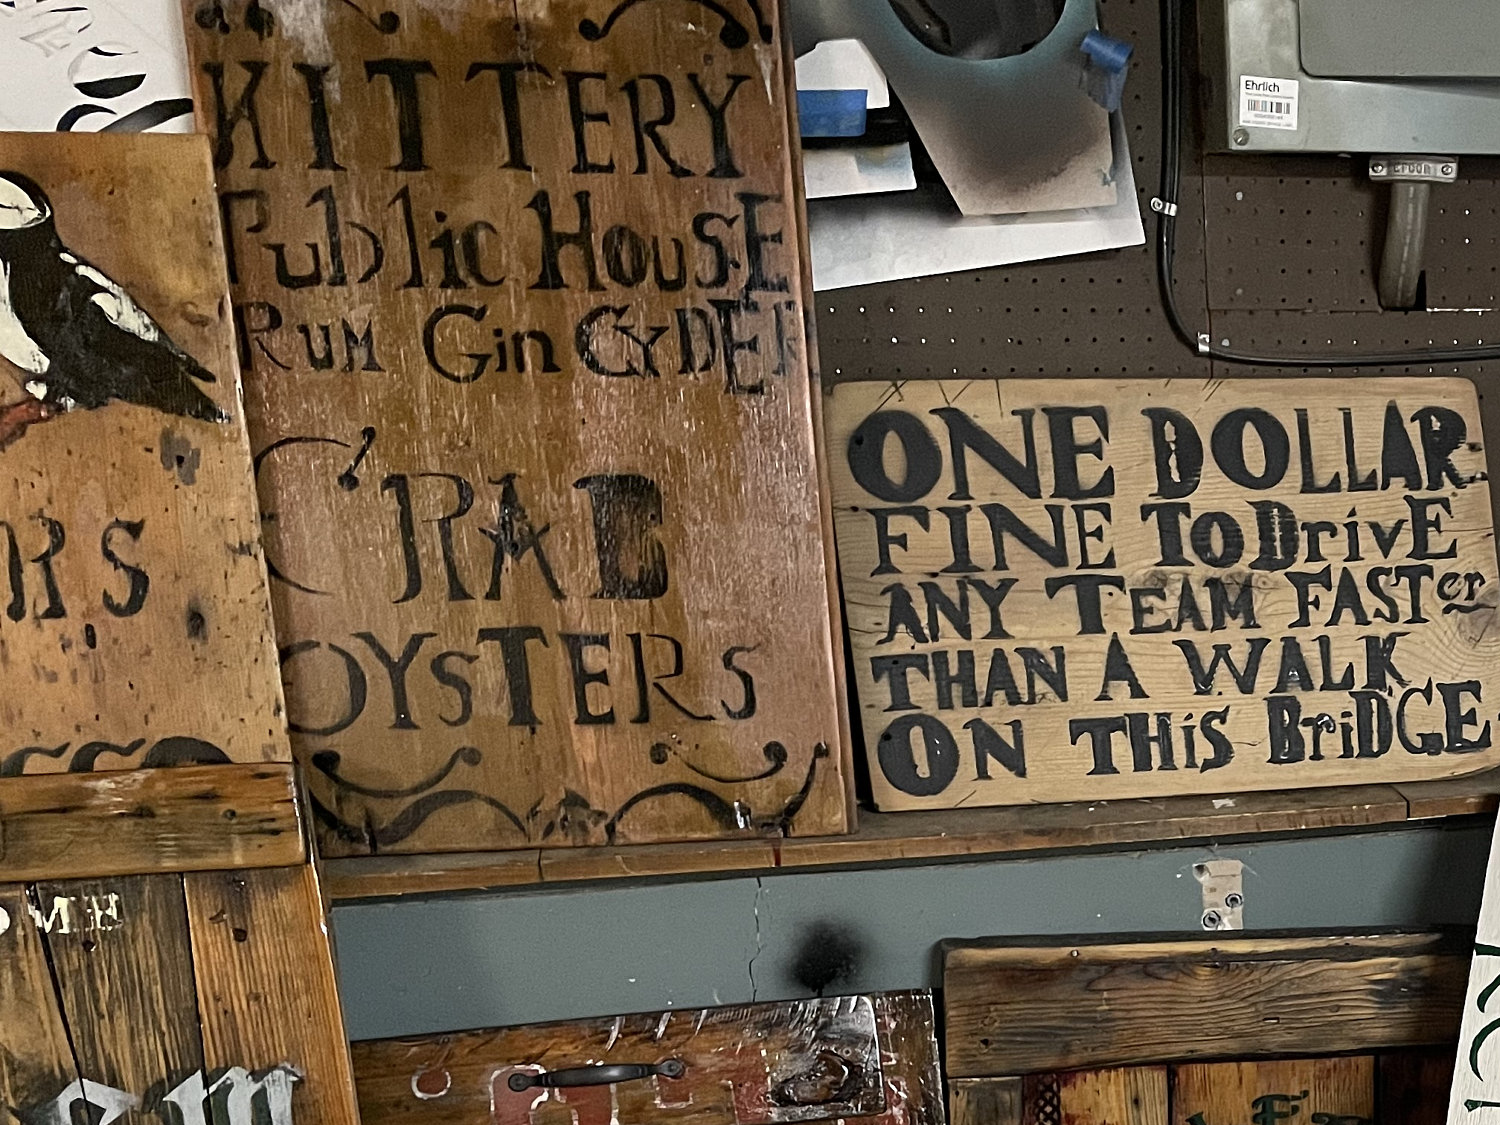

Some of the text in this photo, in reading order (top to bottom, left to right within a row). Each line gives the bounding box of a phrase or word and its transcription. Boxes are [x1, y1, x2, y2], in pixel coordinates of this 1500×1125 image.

[201, 59, 753, 180] KITTERY
[1245, 80, 1280, 93] Ehrlich
[422, 302, 561, 384] Gin
[846, 400, 1486, 503] ONE DOLLAR
[868, 503, 1115, 577] FINE
[876, 576, 1021, 646] ANY
[869, 632, 1411, 714] THAN A WALK
[876, 712, 1026, 798] ON
